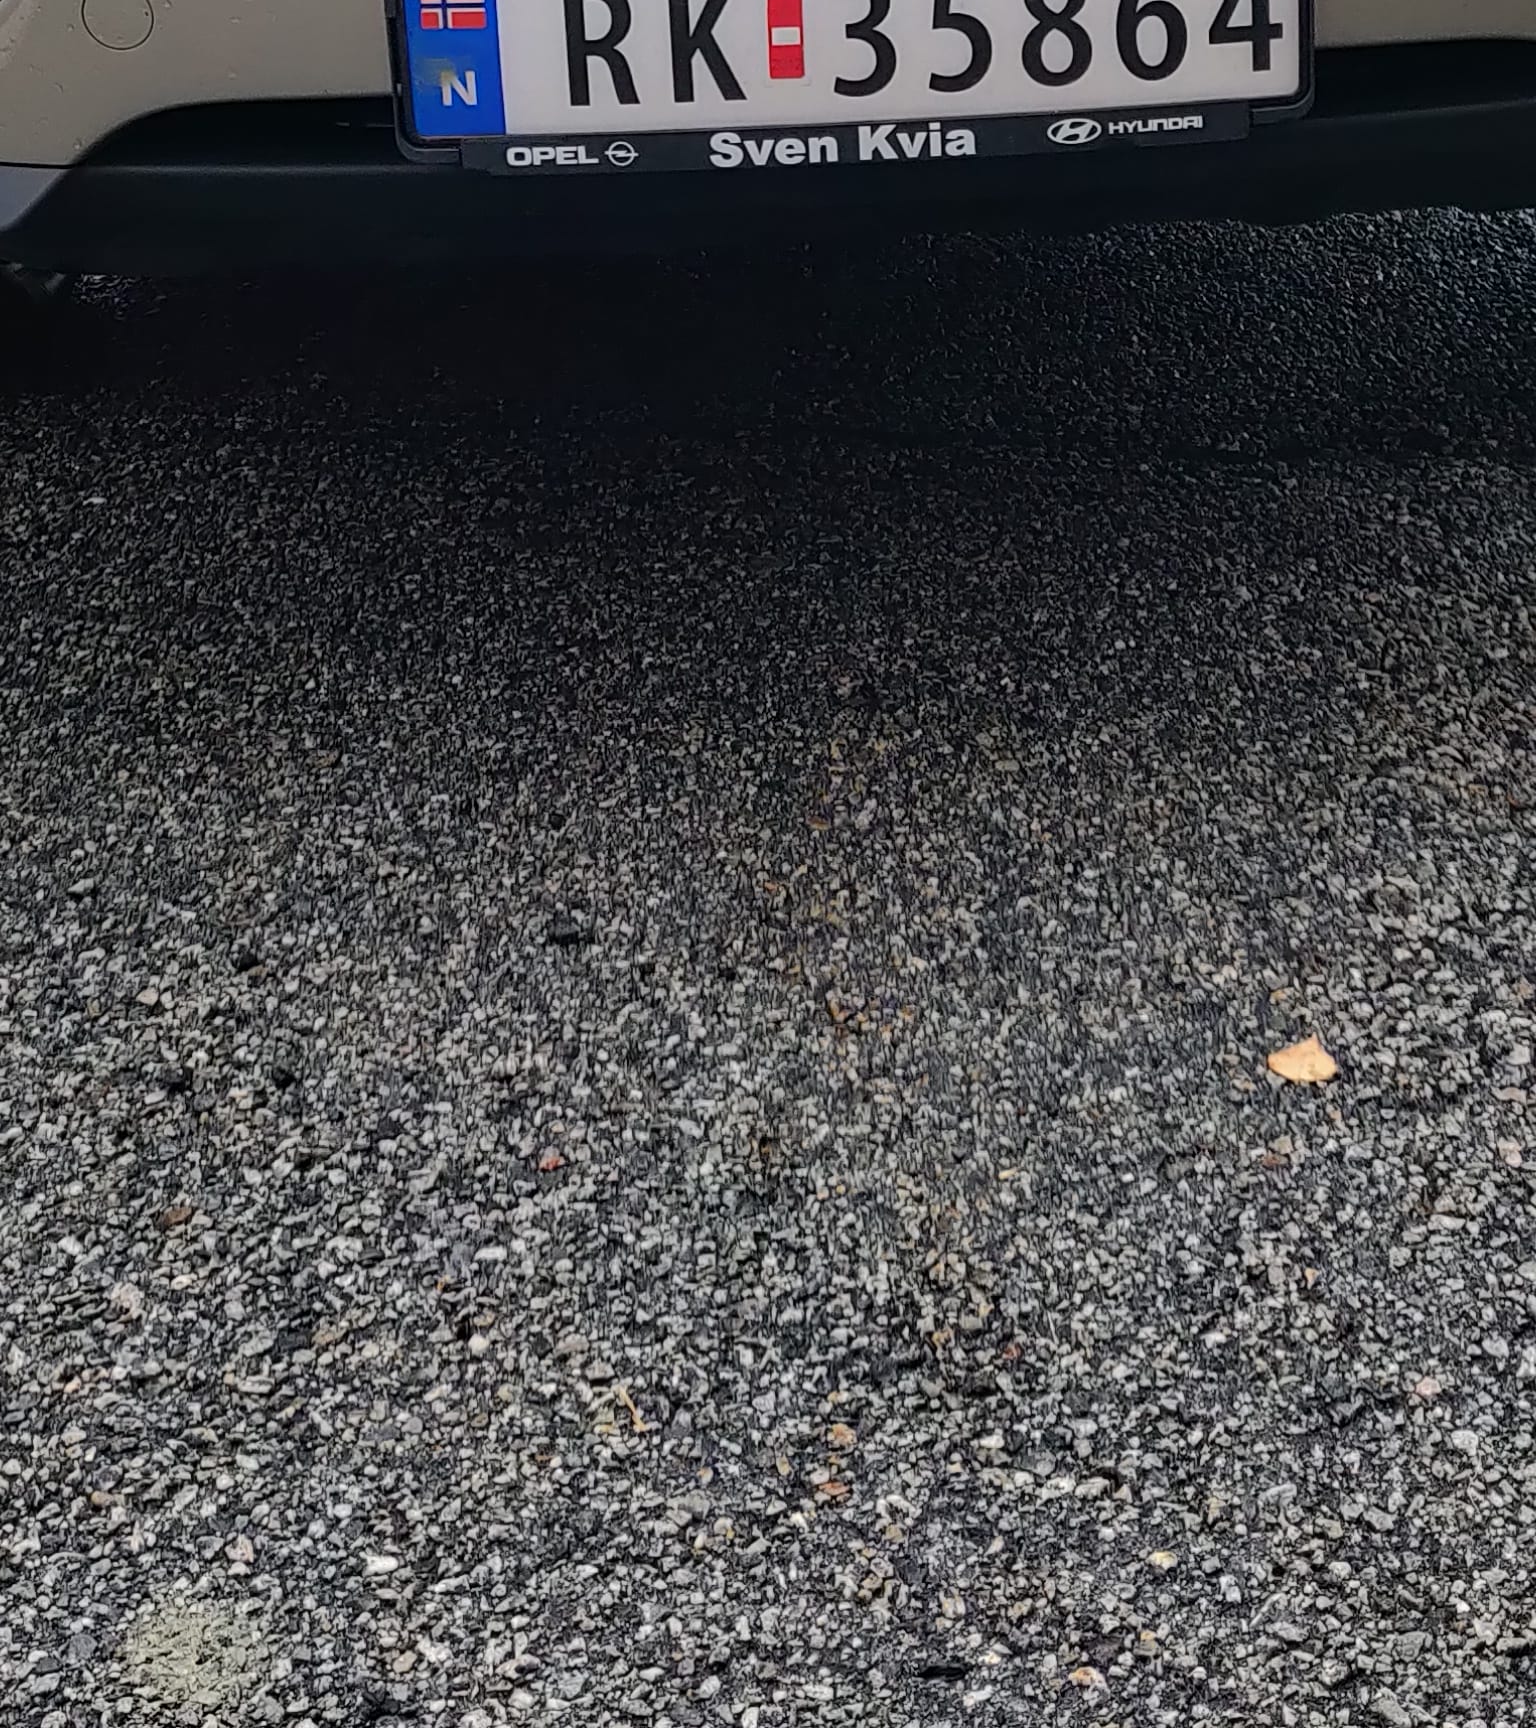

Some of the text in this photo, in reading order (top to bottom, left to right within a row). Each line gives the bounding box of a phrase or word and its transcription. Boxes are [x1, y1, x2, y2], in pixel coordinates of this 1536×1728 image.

[439, 70, 478, 107] N
[1108, 115, 1204, 135] HYUNDAI
[506, 145, 600, 167] OPEL
[709, 121, 977, 169] Sven Kvia
